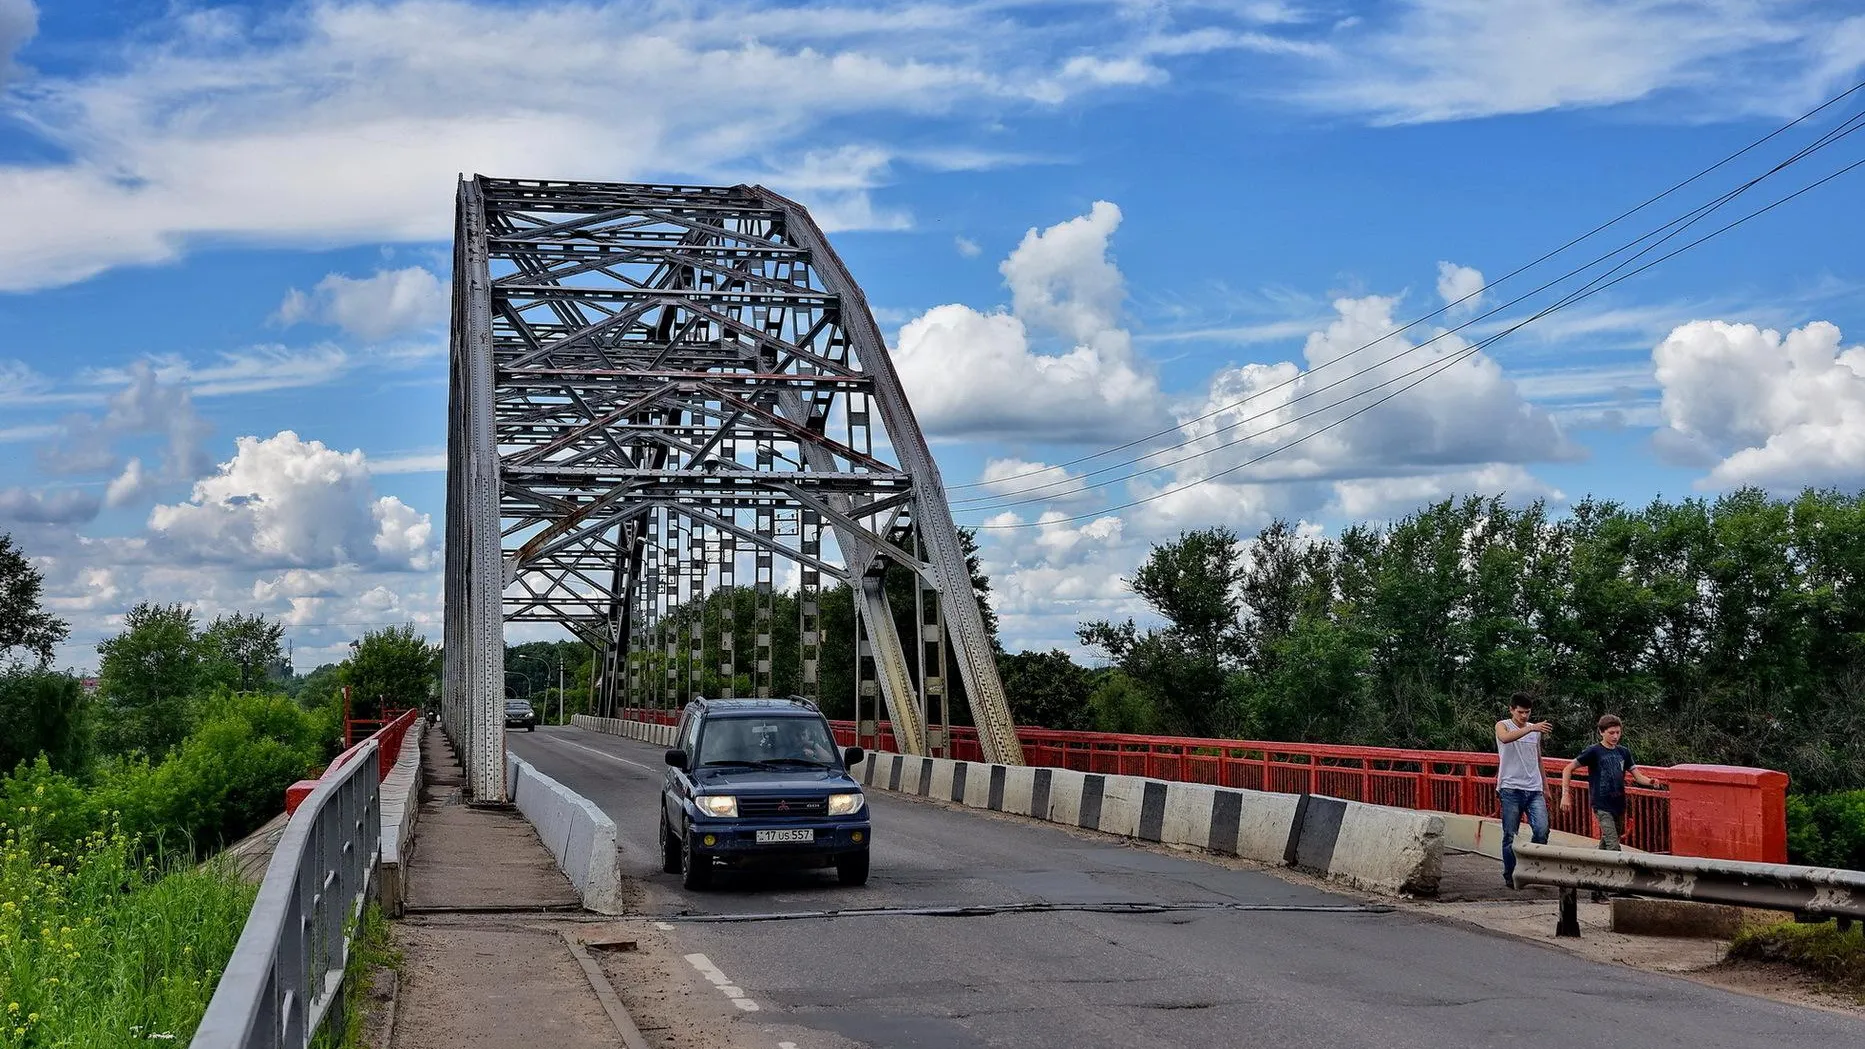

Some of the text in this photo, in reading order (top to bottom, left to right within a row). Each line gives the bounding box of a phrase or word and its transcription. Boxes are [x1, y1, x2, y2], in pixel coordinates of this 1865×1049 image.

[765, 830, 809, 840] 17 US 557
